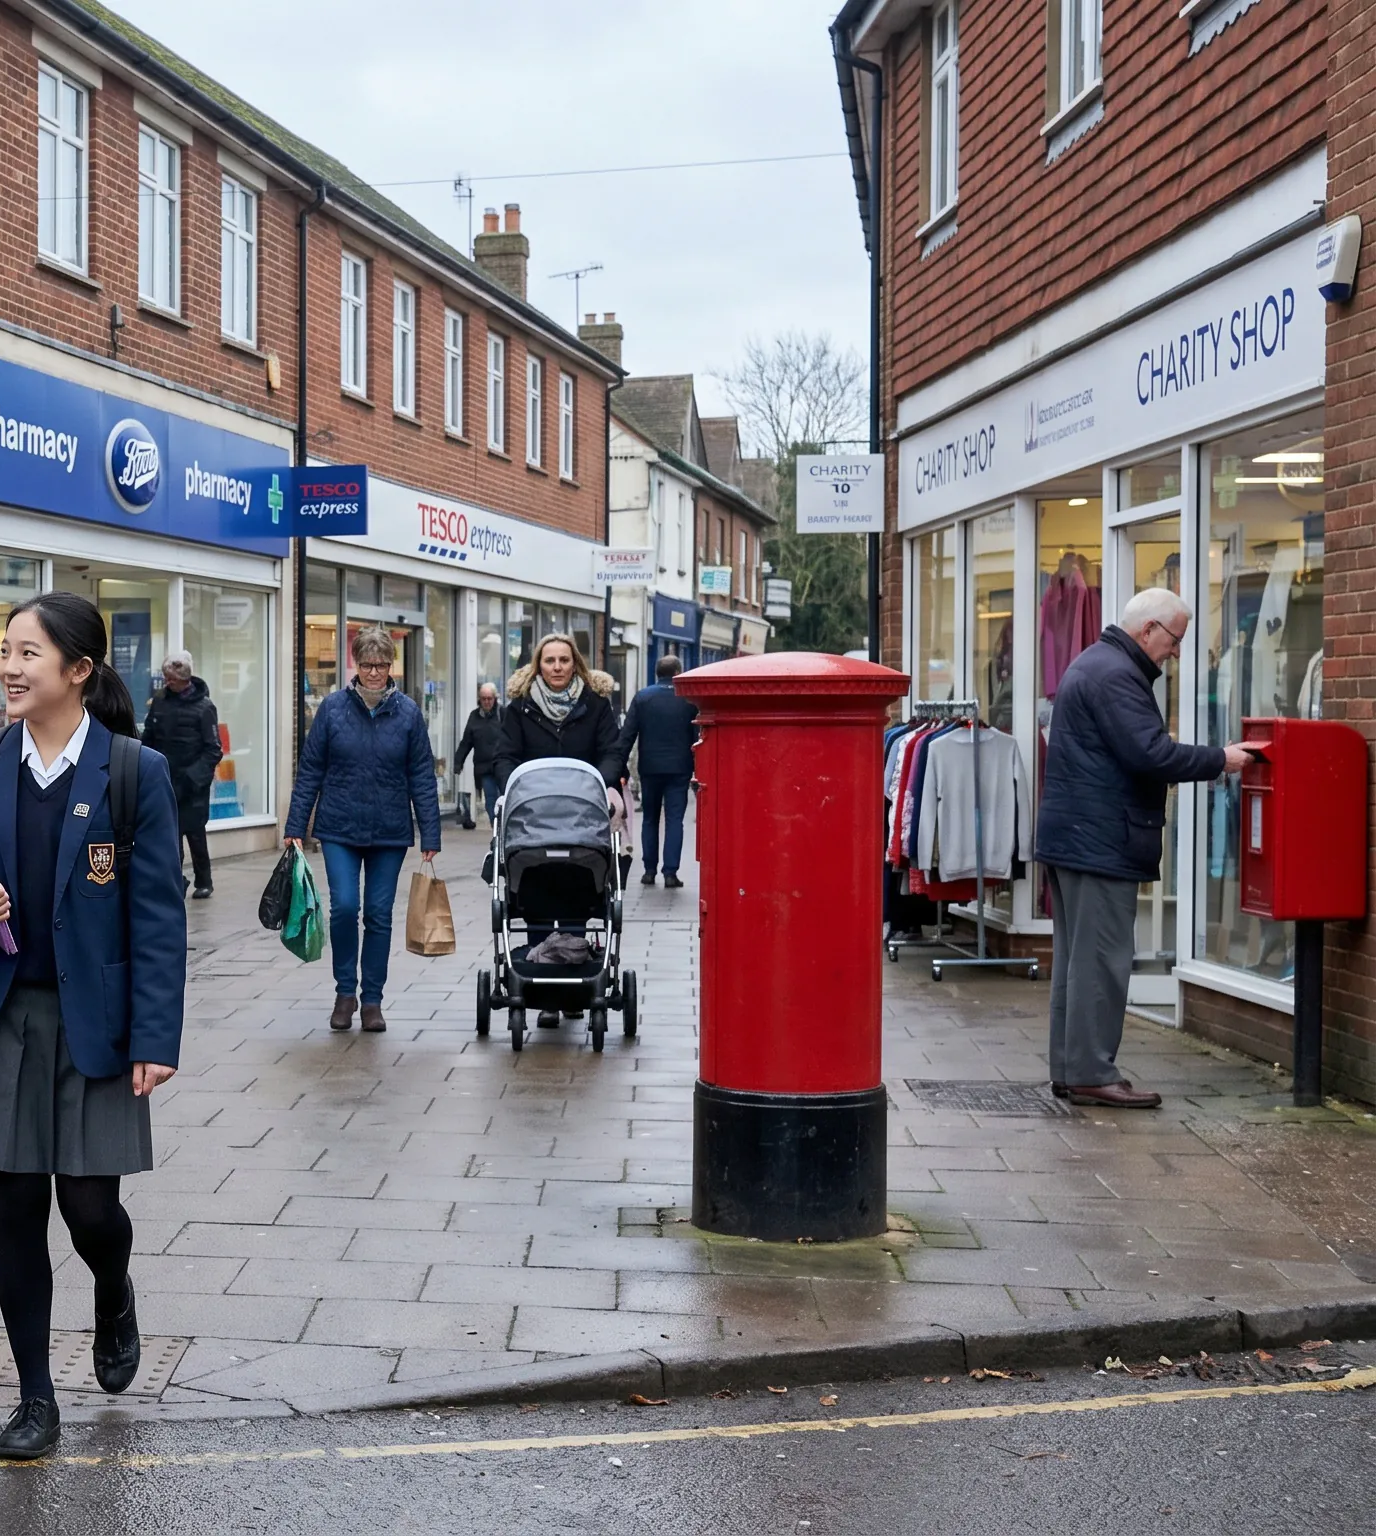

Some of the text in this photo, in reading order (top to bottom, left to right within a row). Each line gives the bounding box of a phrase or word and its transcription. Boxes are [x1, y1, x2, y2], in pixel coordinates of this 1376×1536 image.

[1136, 287, 1295, 406] CHARITY SHOP
[809, 464, 872, 476] CHARITY
[915, 424, 996, 495] CHARITY SHOP
[185, 460, 252, 515] pharmacy
[299, 483, 360, 497] TESCO
[300, 501, 359, 519] express
[417, 502, 513, 560] TESCO express
